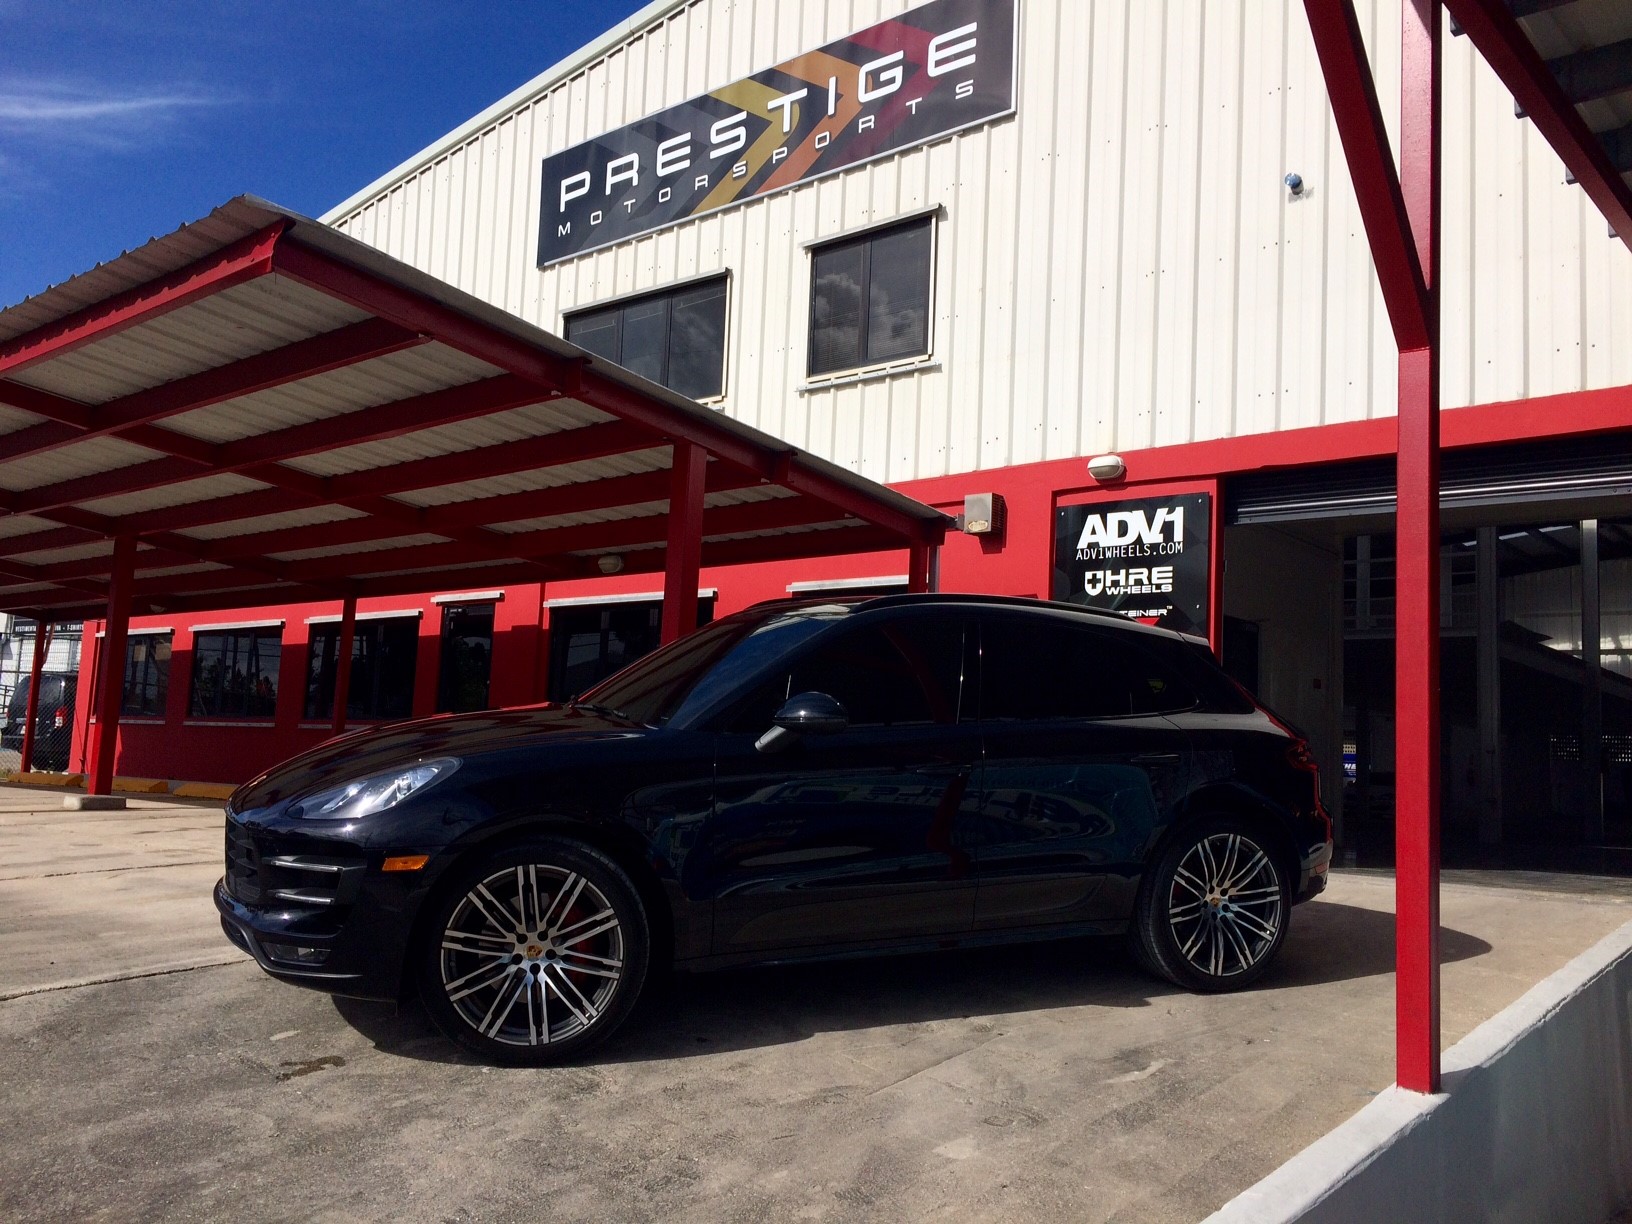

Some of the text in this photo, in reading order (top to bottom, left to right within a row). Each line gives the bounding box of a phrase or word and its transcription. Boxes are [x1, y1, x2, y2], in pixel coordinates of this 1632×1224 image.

[559, 22, 978, 213] PRESTIGE
[557, 79, 974, 238] MOTORSPORTS
[1076, 542, 1184, 561] ADV1WHEELS.COM
[1105, 565, 1174, 587] HRE
[1106, 584, 1173, 596] WHEELS
[1118, 608, 1168, 617] TEINER
